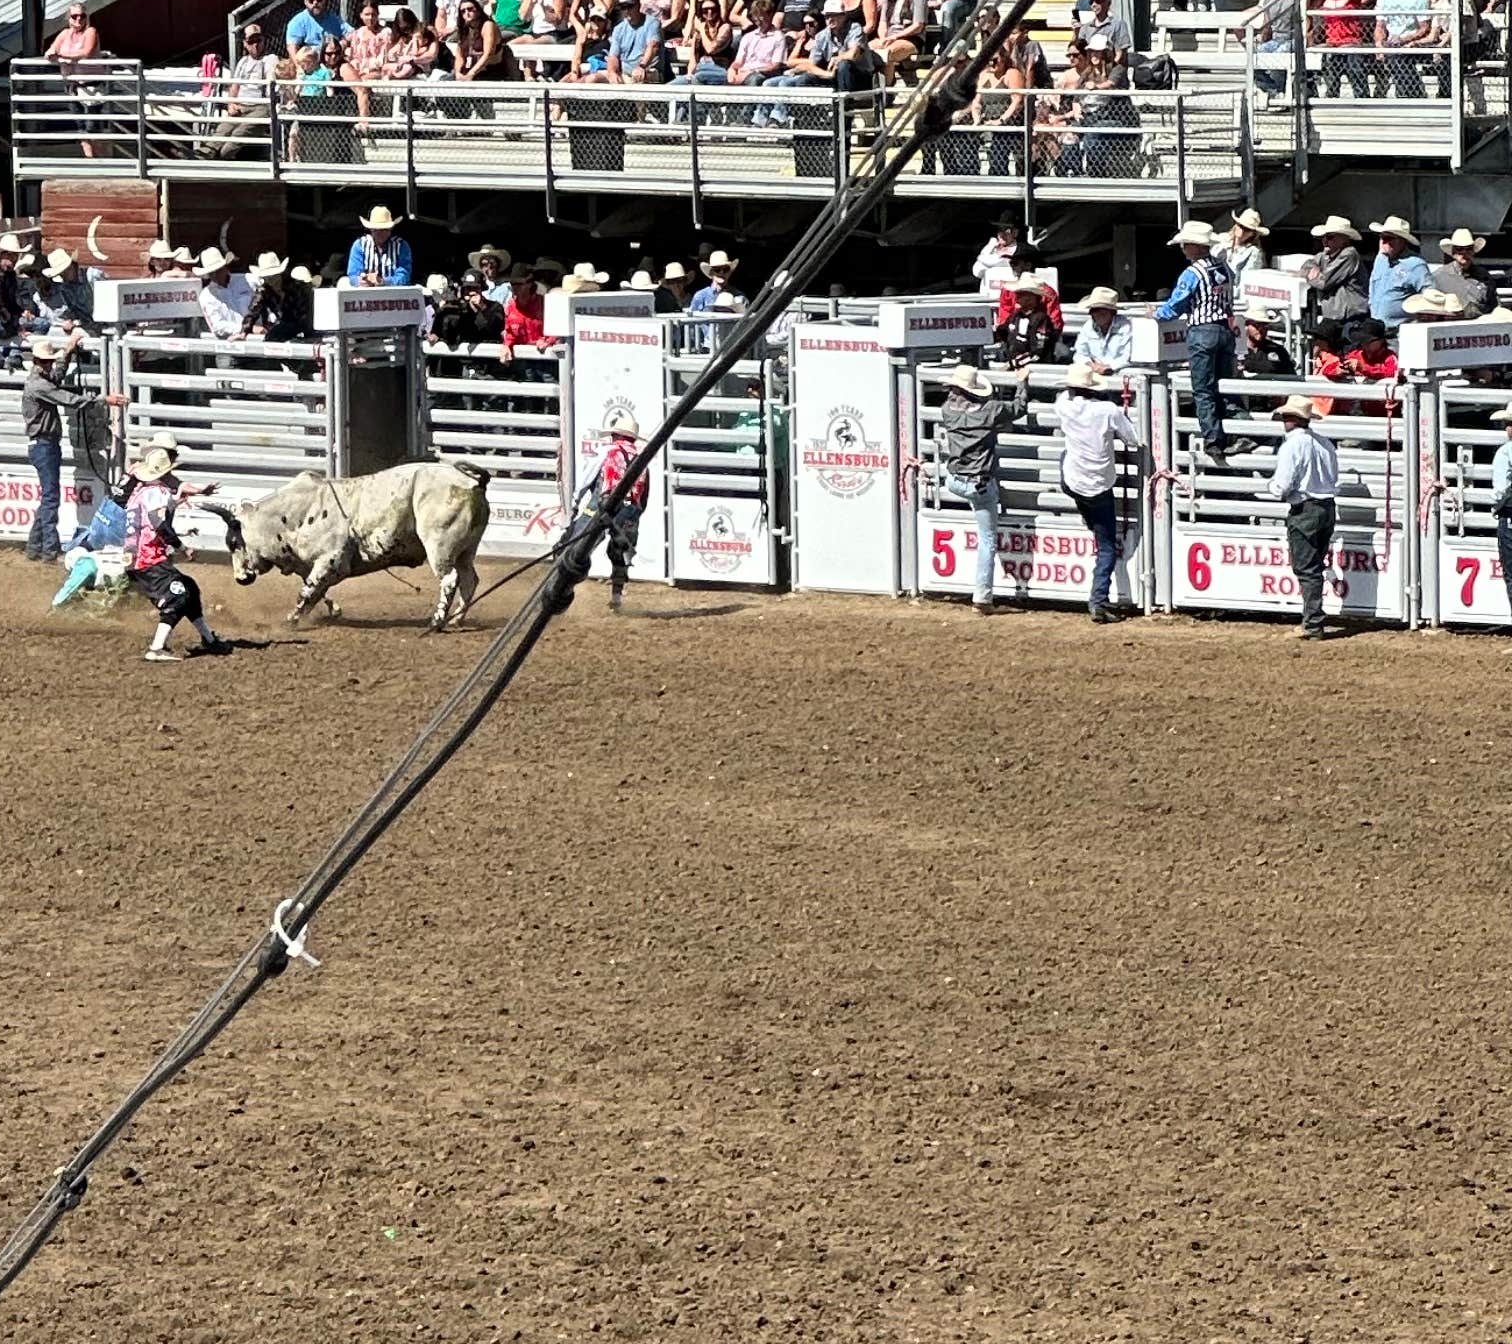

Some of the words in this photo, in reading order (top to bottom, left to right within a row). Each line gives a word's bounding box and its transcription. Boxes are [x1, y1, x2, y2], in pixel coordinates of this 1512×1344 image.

[123, 290, 197, 305] ELLENSBURG
[344, 299, 420, 313] ELLENSBURG
[909, 316, 987, 331] ELLENSBURG
[579, 330, 659, 346] ELLENSBURG
[1433, 333, 1511, 351] ELLENSBURG
[803, 451, 889, 468] ELLENSBURG
[689, 539, 752, 553] ELLENSBURG
[932, 528, 956, 577] 5
[964, 530, 1124, 559] ELENSBU
[1002, 560, 1086, 584] RODEO
[1187, 542, 1211, 592] 6
[1221, 542, 1389, 573] ELLEBURG
[1260, 573, 1349, 599] ROO
[1456, 556, 1480, 607] 7
